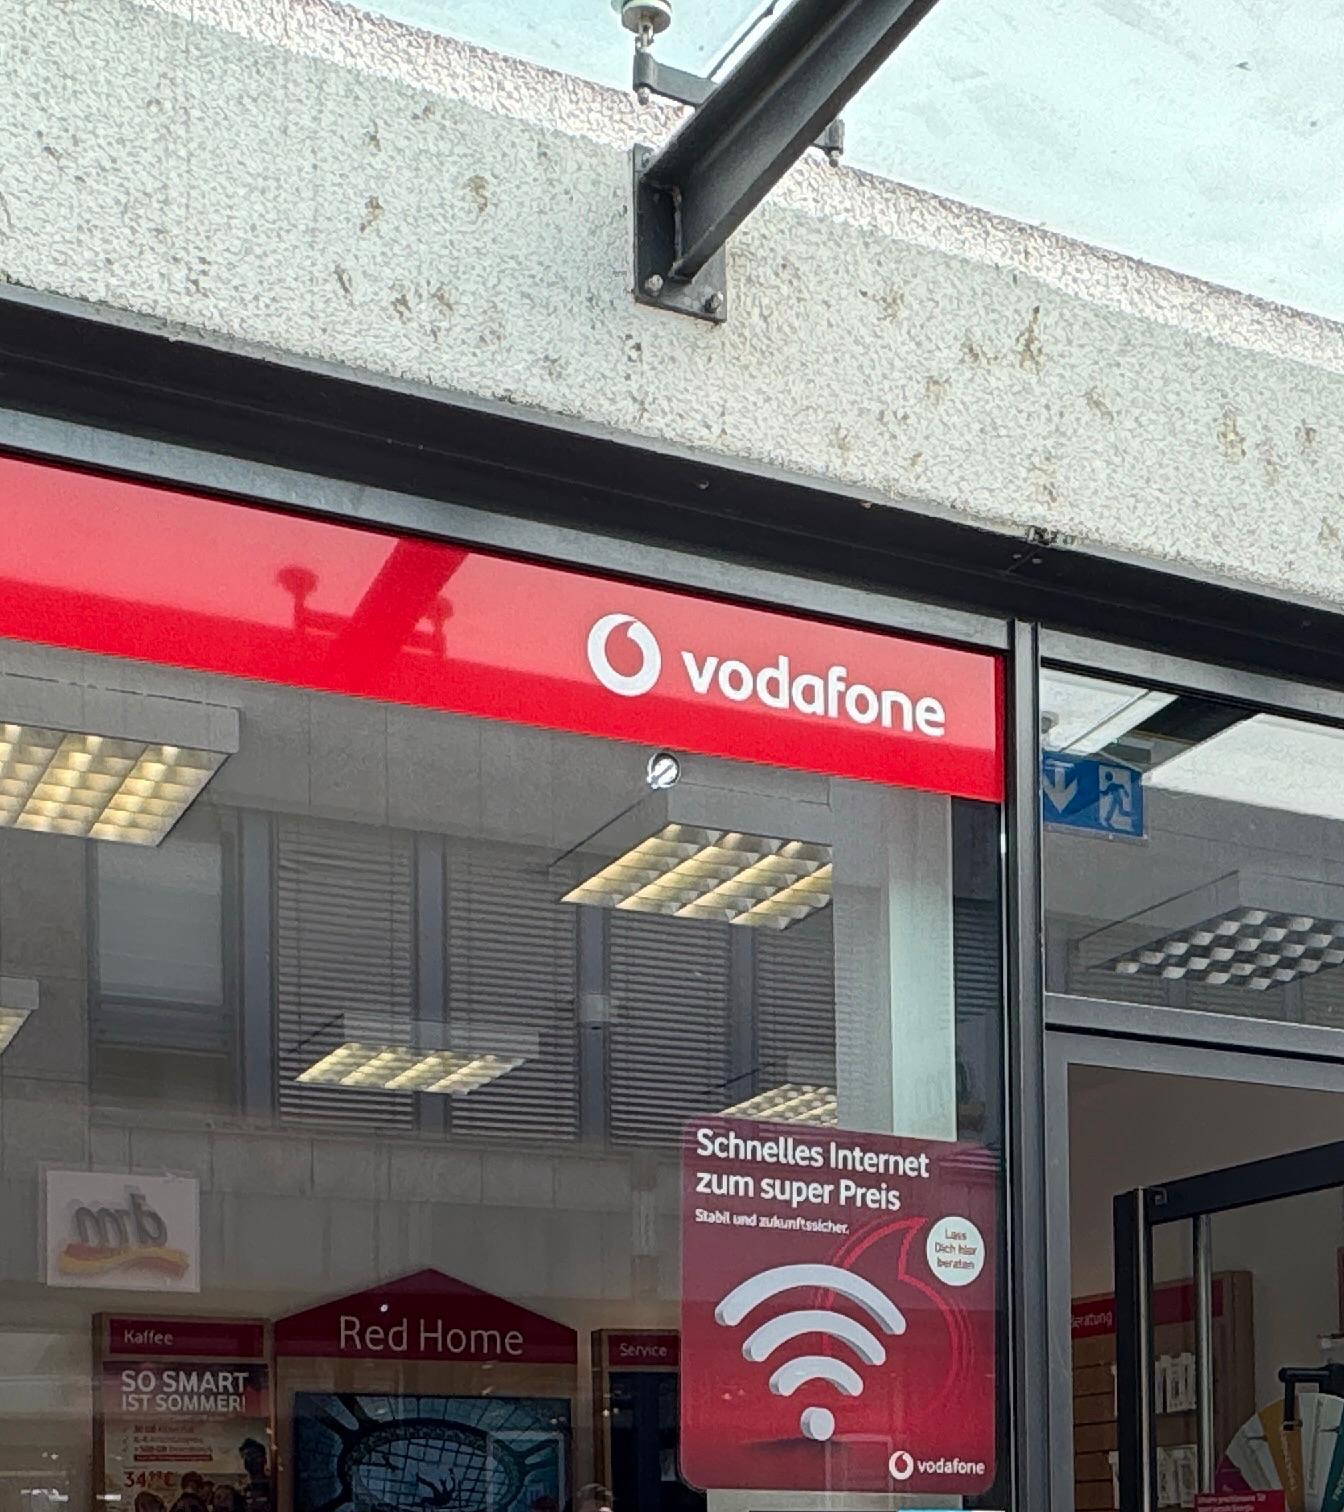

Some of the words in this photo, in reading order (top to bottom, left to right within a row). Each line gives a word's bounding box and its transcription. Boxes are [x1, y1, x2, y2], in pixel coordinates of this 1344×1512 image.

[680, 650, 946, 736] vodafone
[696, 1128, 824, 1168] Schnelles
[829, 1142, 930, 1178] Internet
[696, 1172, 754, 1197] zum
[760, 1177, 834, 1208] super
[839, 1179, 901, 1211] Preis
[695, 1208, 731, 1223] Stabil
[733, 1212, 757, 1227] und
[758, 1214, 850, 1235] zukunftssicher.
[123, 1329, 174, 1346] Kaffee
[339, 1314, 408, 1353] Red
[419, 1318, 524, 1356] Home
[619, 1342, 668, 1358] Service
[121, 1370, 156, 1392] SO
[162, 1370, 250, 1394] SMART
[121, 1394, 153, 1411] IST
[917, 1456, 986, 1476] vodafone
